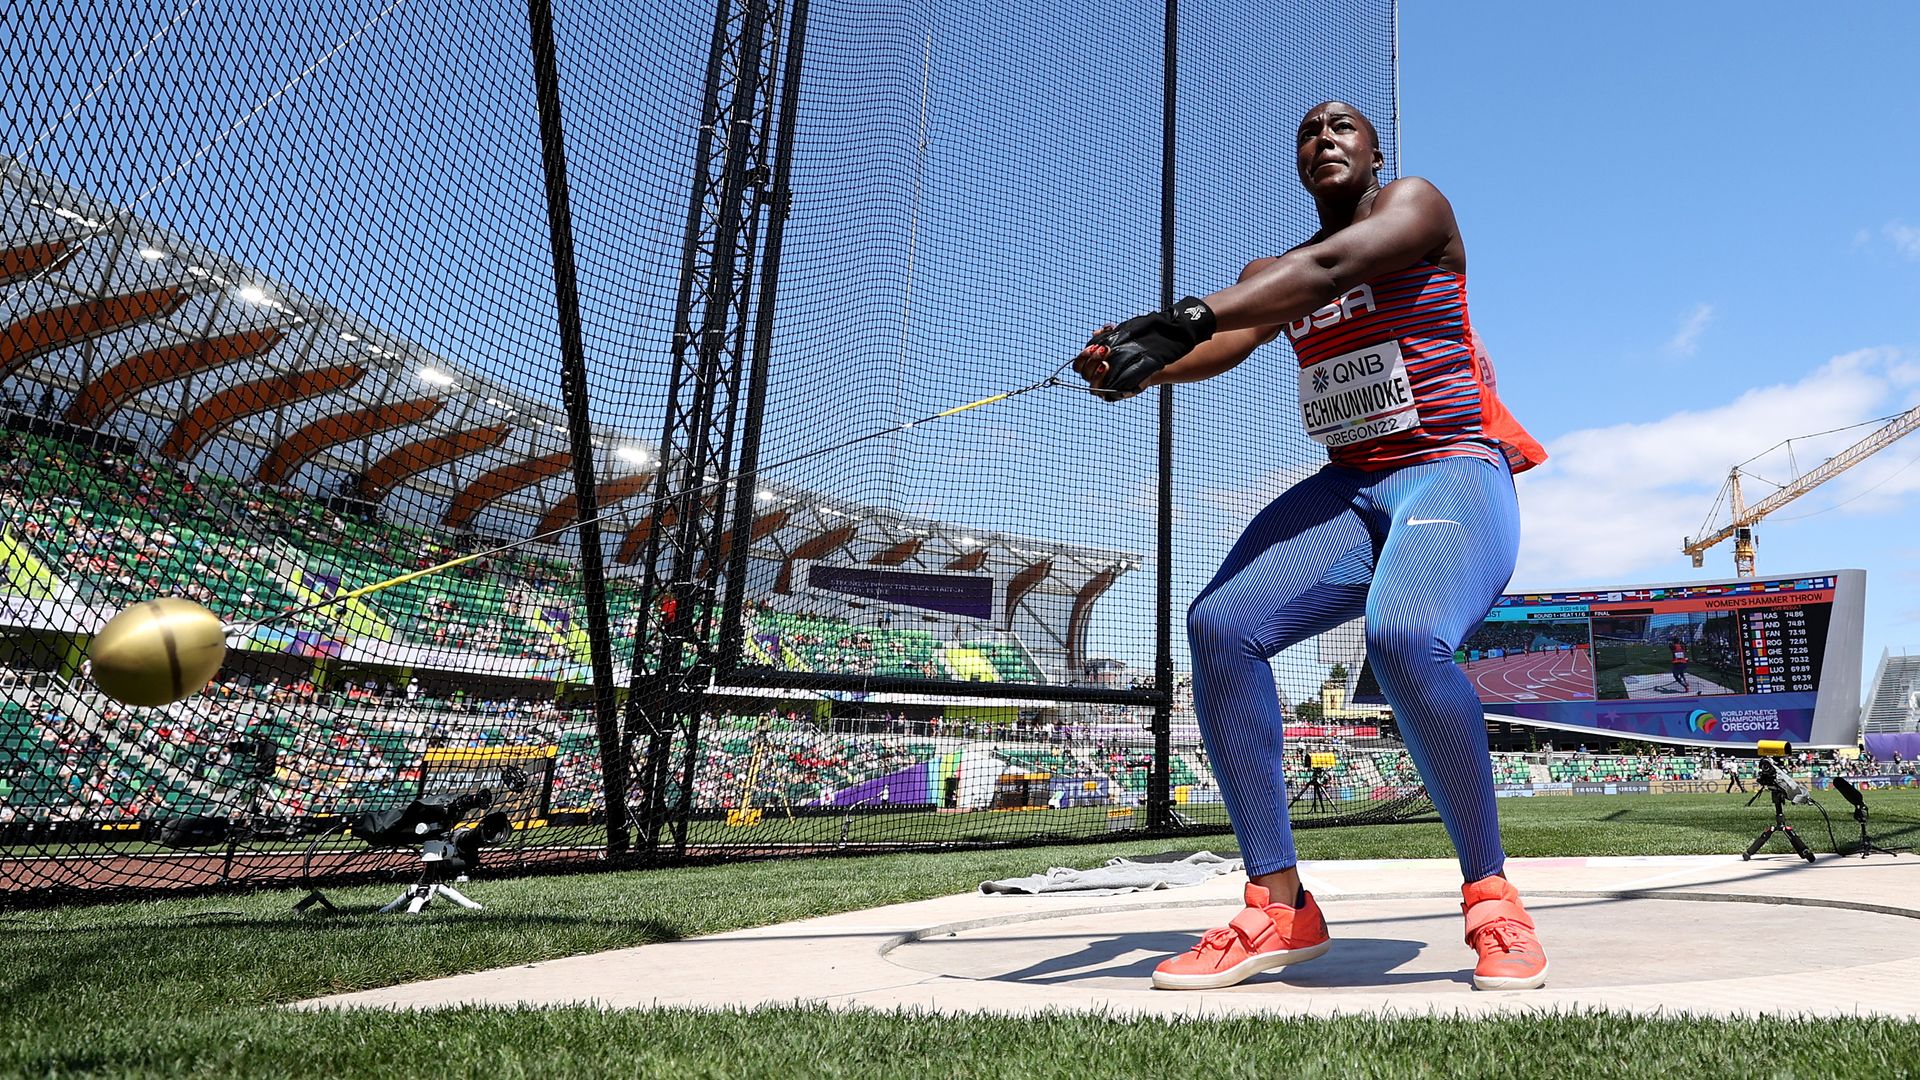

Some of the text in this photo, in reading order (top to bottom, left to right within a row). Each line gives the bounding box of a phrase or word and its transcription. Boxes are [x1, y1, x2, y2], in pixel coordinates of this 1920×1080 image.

[1288, 283, 1376, 339] USA
[1333, 353, 1384, 384] QNB
[1303, 377, 1408, 428] ECHIKUNWOKE
[1325, 418, 1399, 446] OREGON22
[1705, 593, 1823, 608] WOMEN'S HAMMER THROW
[1721, 714, 1779, 723] CHAMPIONSHIPS
[1744, 708, 1778, 716] ATHLETICS
[1722, 721, 1780, 732] OREGON22
[1662, 780, 1719, 794] SEIKO
